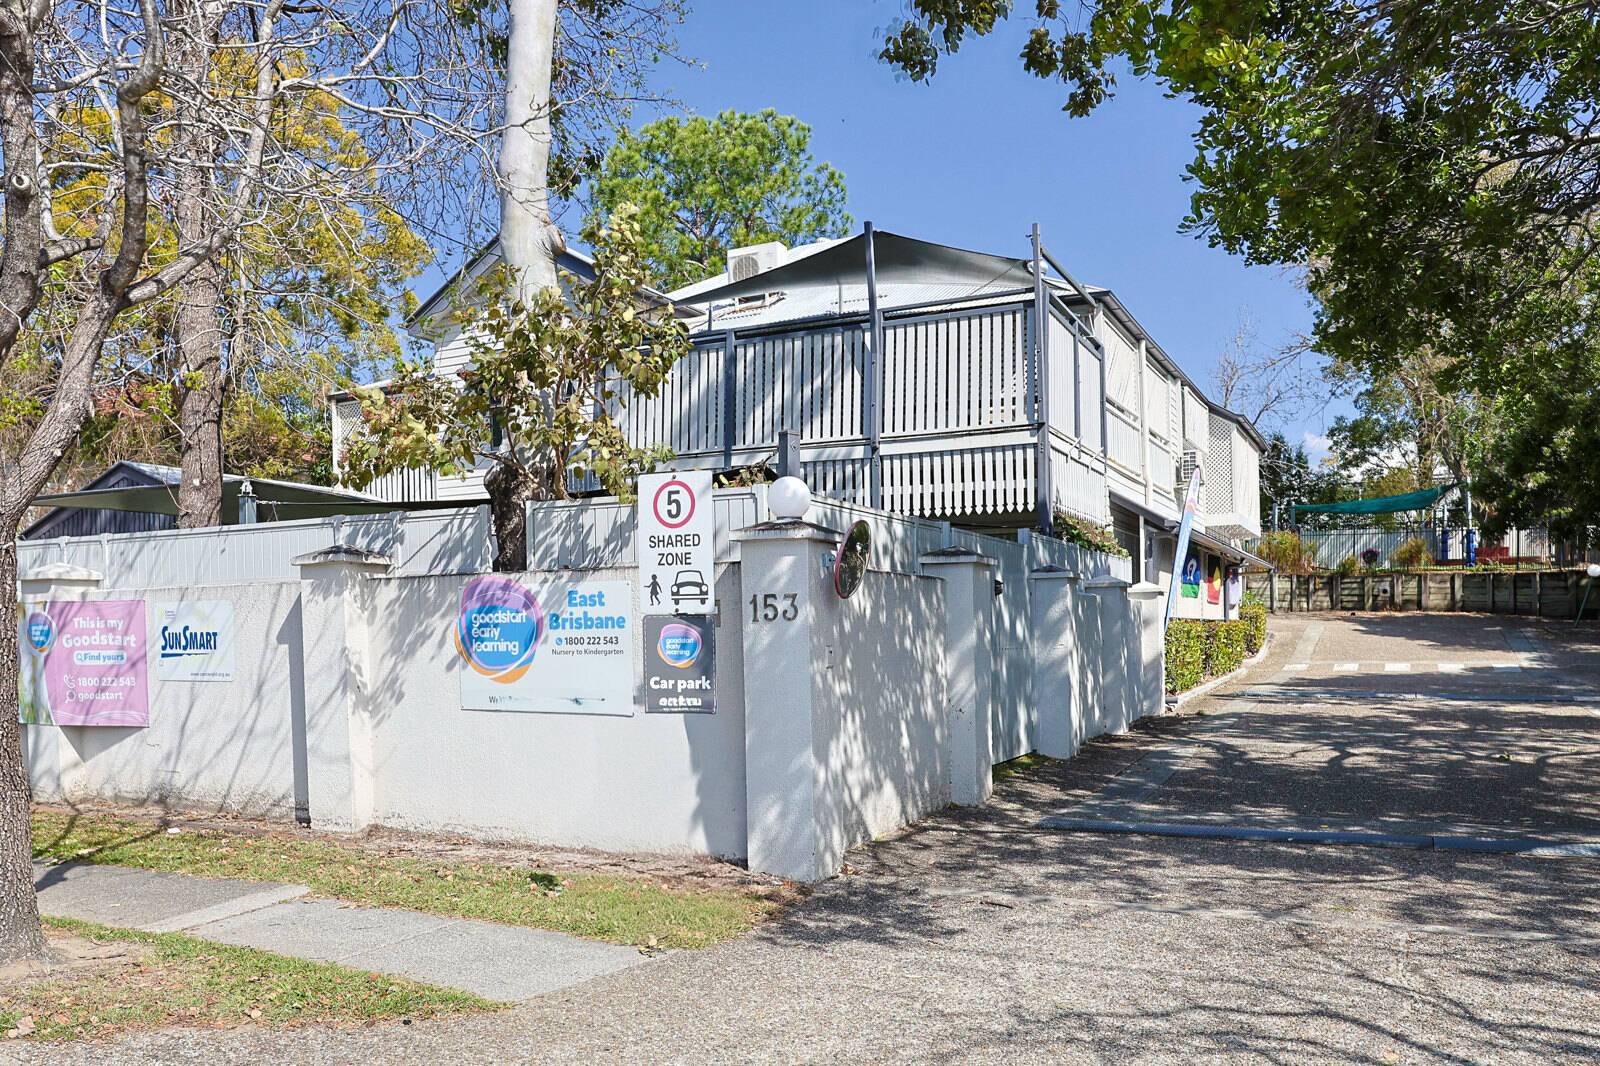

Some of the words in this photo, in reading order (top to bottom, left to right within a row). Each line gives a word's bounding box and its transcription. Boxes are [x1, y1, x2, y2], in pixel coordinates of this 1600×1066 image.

[666, 489, 682, 519] 5
[648, 533, 701, 549] SHARED
[657, 552, 692, 566] ZONE
[567, 590, 605, 607] East
[749, 593, 799, 623] 153
[72, 617, 96, 630] This
[96, 617, 105, 630] is
[107, 619, 124, 631] my
[471, 610, 527, 627] goodstart
[548, 611, 626, 631] Brisbane
[62, 631, 136, 648] Goodstart
[471, 624, 501, 640] early
[472, 638, 520, 655] learning
[564, 637, 585, 646] 1800
[586, 636, 602, 645] 222
[603, 636, 620, 645] 543
[84, 652, 101, 662] Find
[102, 653, 125, 664] yours
[551, 648, 575, 656] Nursery
[576, 648, 583, 656] to
[583, 647, 624, 656] Kindergarten
[78, 676, 99, 687] 1800
[100, 676, 118, 687] 222
[119, 676, 136, 687] 543
[650, 676, 675, 689] Car
[677, 675, 711, 692] park
[78, 690, 124, 702] goodstart
